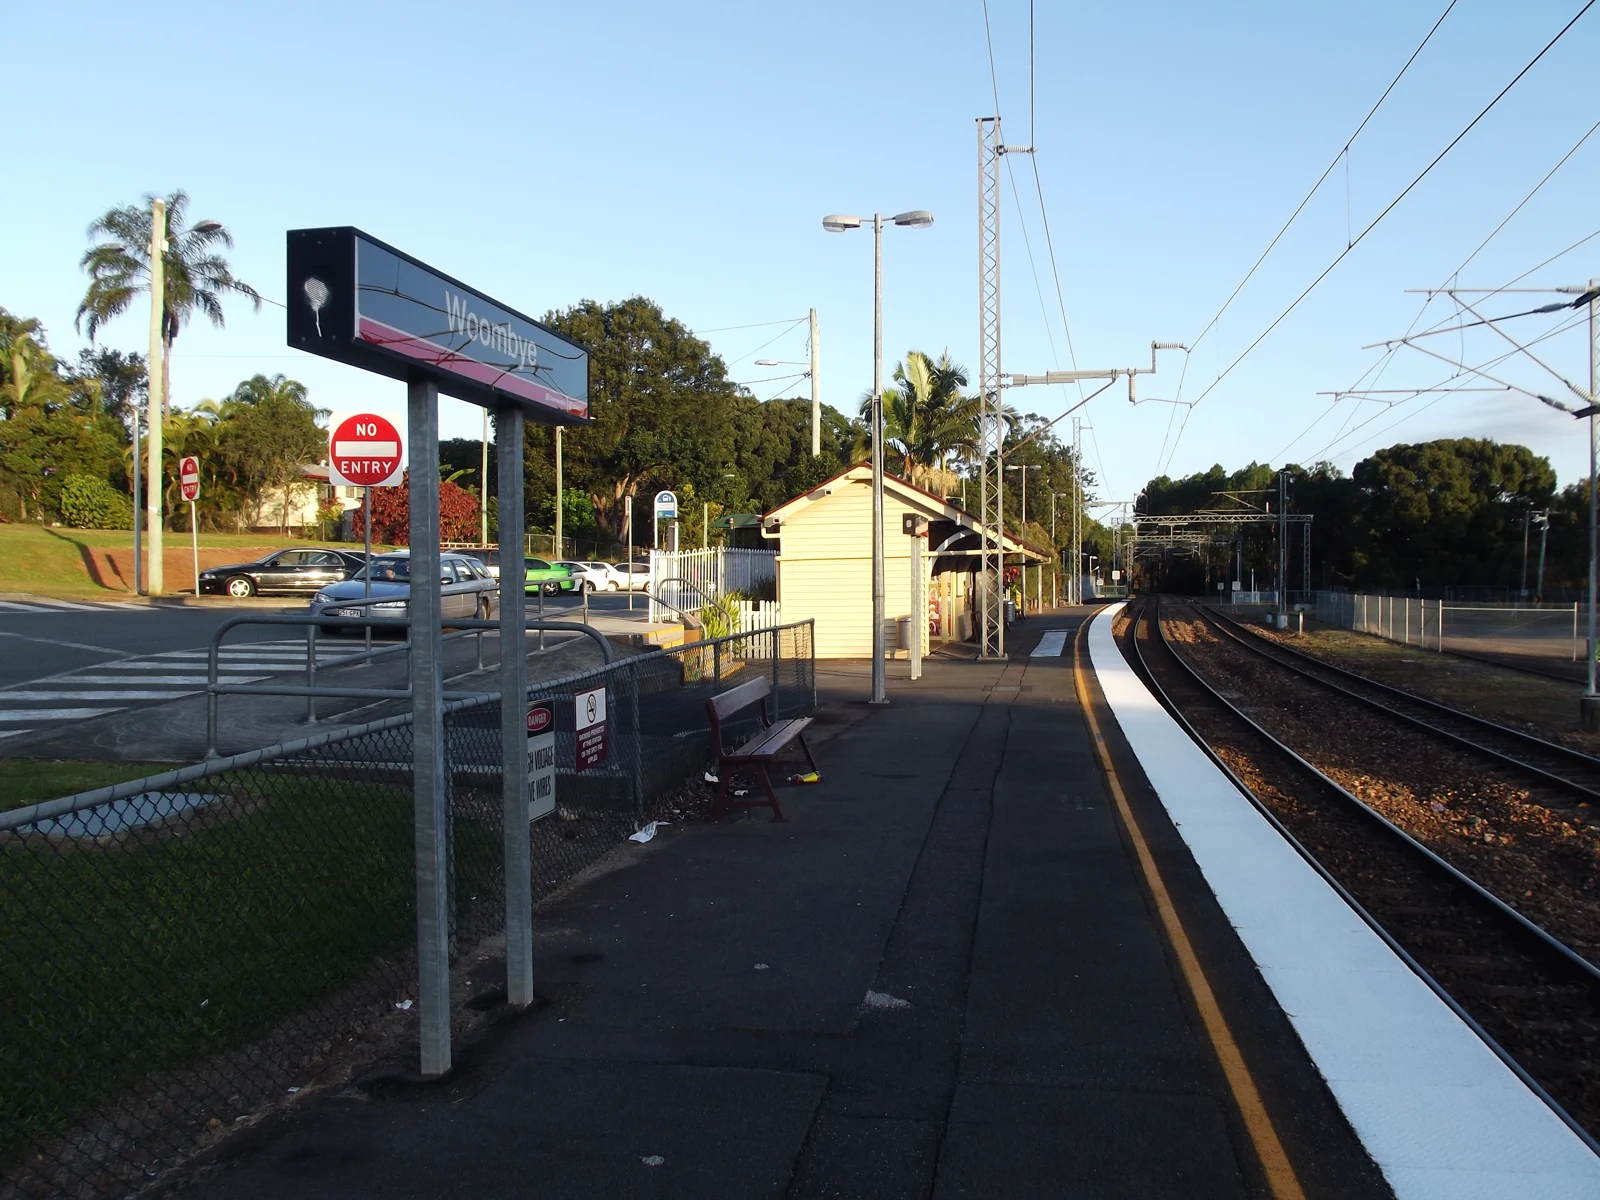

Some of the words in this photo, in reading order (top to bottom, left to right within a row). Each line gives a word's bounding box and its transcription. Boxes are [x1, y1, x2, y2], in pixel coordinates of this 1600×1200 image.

[445, 290, 537, 370] Woombye
[356, 423, 377, 437] NO
[341, 461, 392, 474] ENTRY
[184, 485, 196, 494] ENTRY
[528, 712, 547, 726] DANGER
[534, 745, 554, 770] VOLTAGE
[536, 775, 552, 800] WIRES
